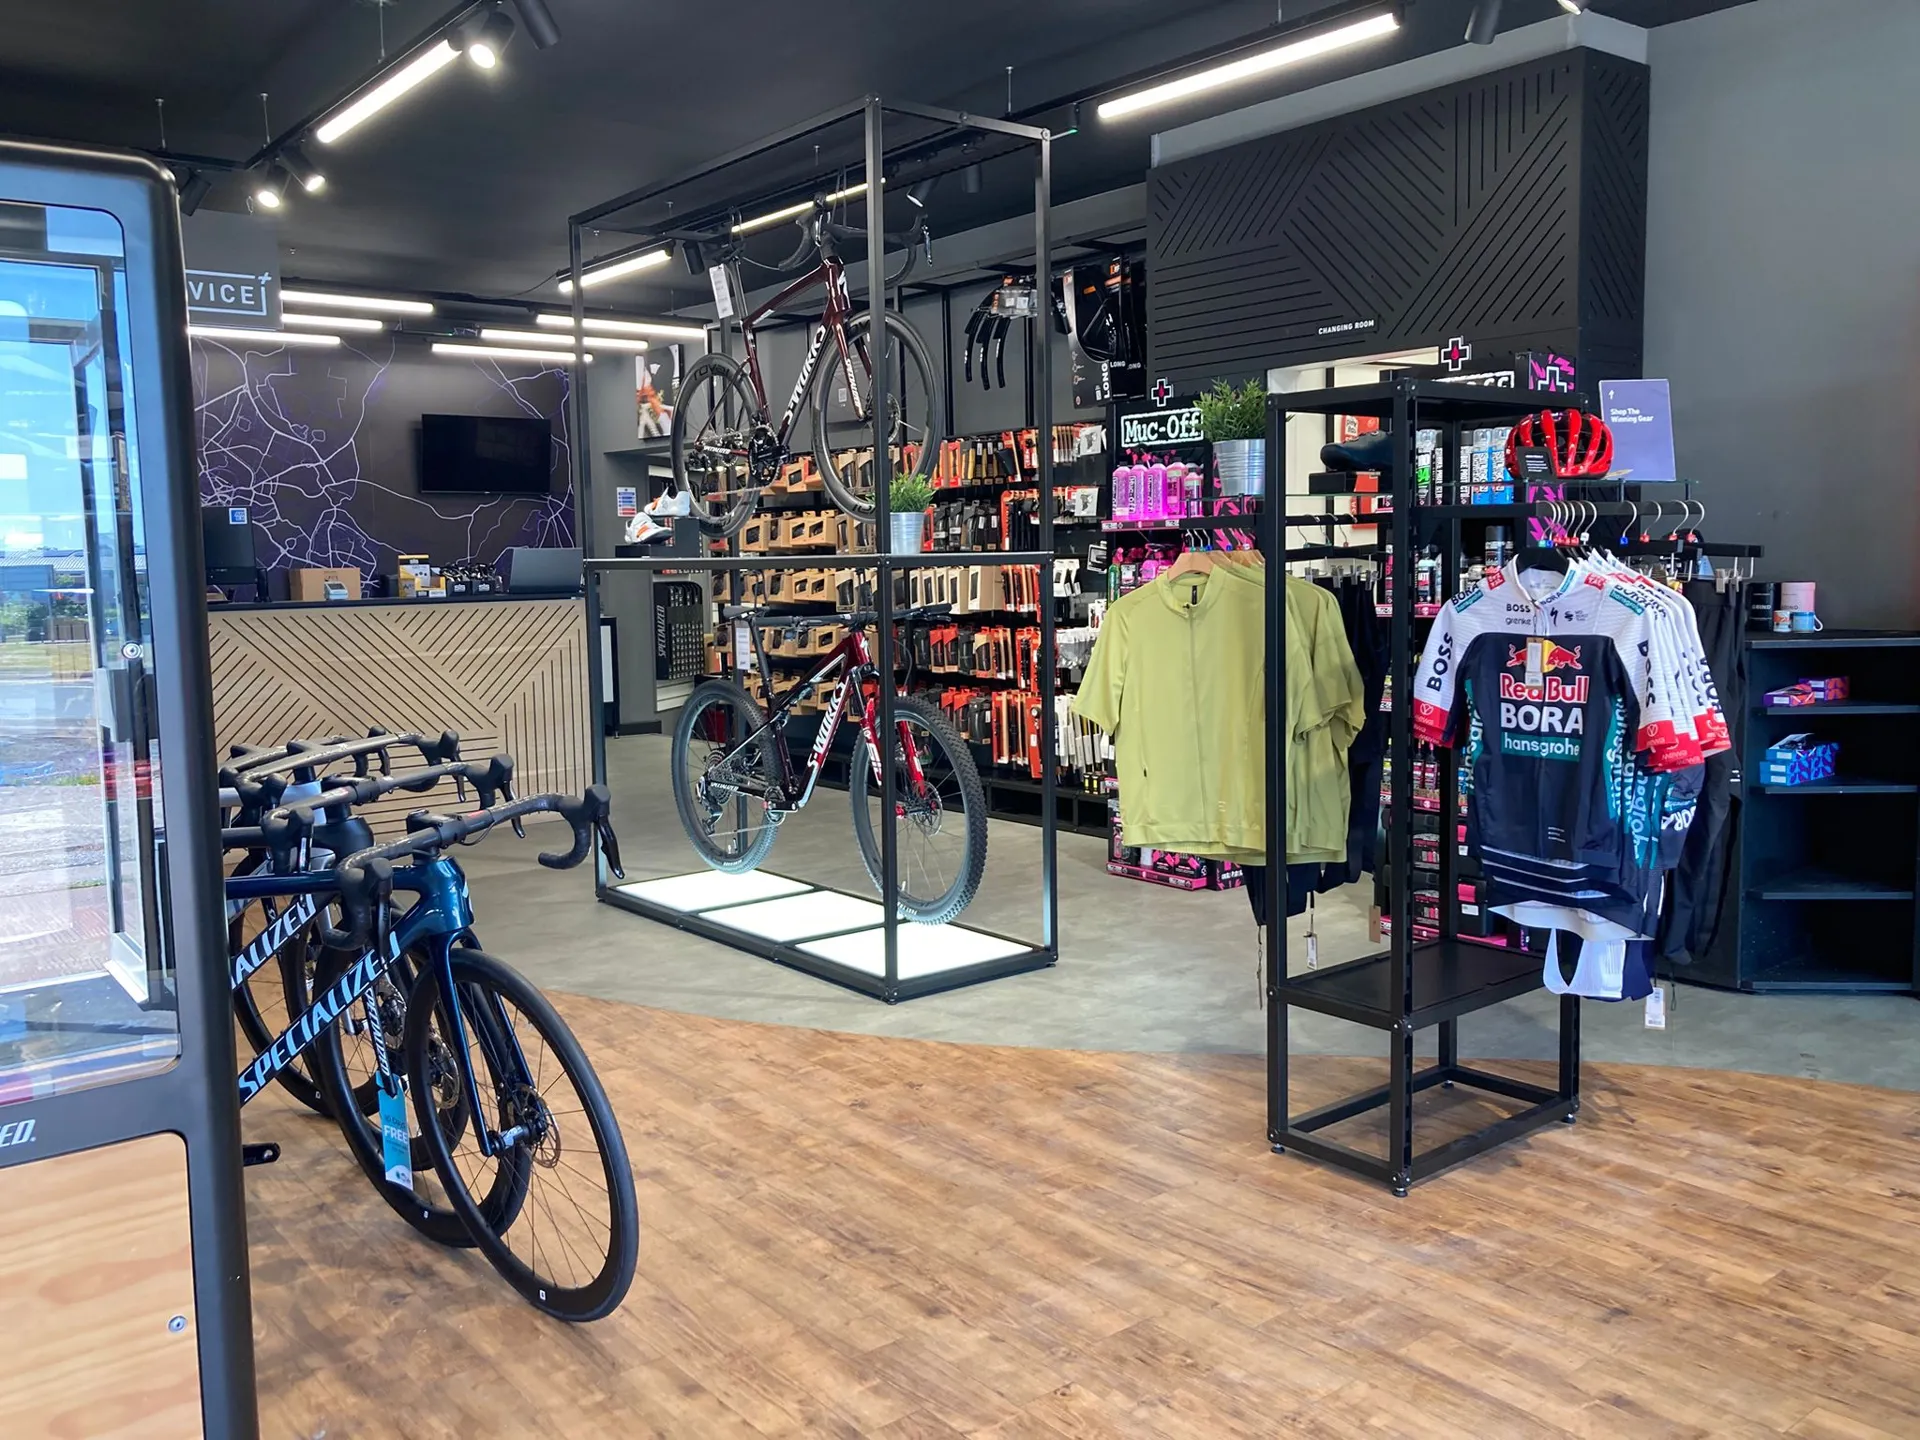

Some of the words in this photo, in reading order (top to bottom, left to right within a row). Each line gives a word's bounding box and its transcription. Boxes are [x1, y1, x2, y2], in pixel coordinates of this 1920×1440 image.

[188, 281, 255, 305] VICE
[1318, 322, 1353, 335] CHANGING
[1354, 319, 1375, 329] ROOM
[1101, 362, 1110, 399] LONG
[1610, 408, 1627, 416] Shop
[1627, 407, 1640, 415] The
[1610, 415, 1637, 424] Winning
[1124, 412, 1200, 443] Muc-Off
[1506, 603, 1531, 613] BOSS
[656, 604, 667, 659] SPECIALIZED
[1505, 617, 1532, 626] grenke
[1426, 632, 1454, 692] BOSS
[1545, 675, 1590, 704] Bull
[1501, 702, 1583, 735] BORA
[1504, 735, 1580, 757] hansgrohe
[232, 893, 317, 990] ALIZED
[384, 1124, 409, 1145] FREE
